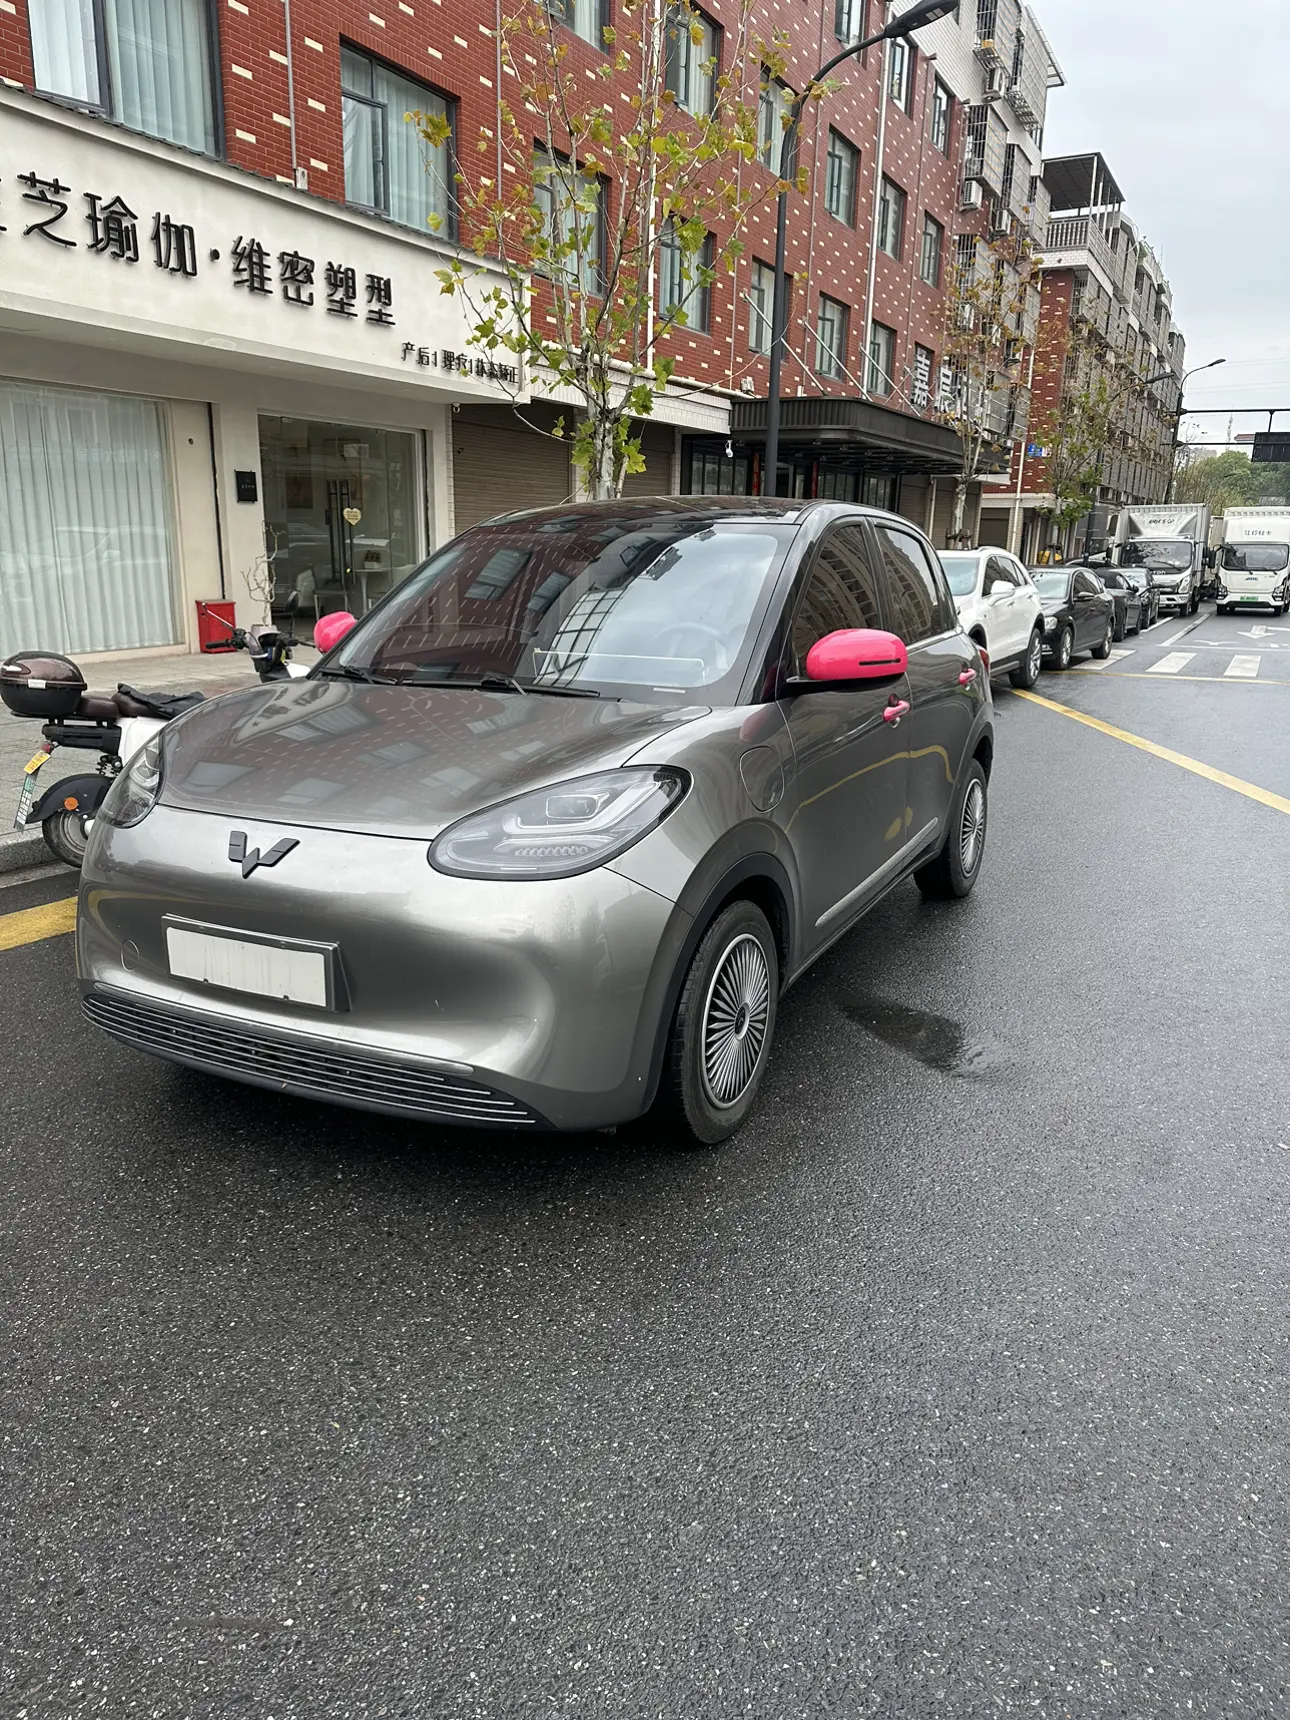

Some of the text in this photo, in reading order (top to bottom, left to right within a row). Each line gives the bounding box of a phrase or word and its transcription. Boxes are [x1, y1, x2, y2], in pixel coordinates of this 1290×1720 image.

[0, 171, 396, 326] 芝瑜伽·维密塑型
